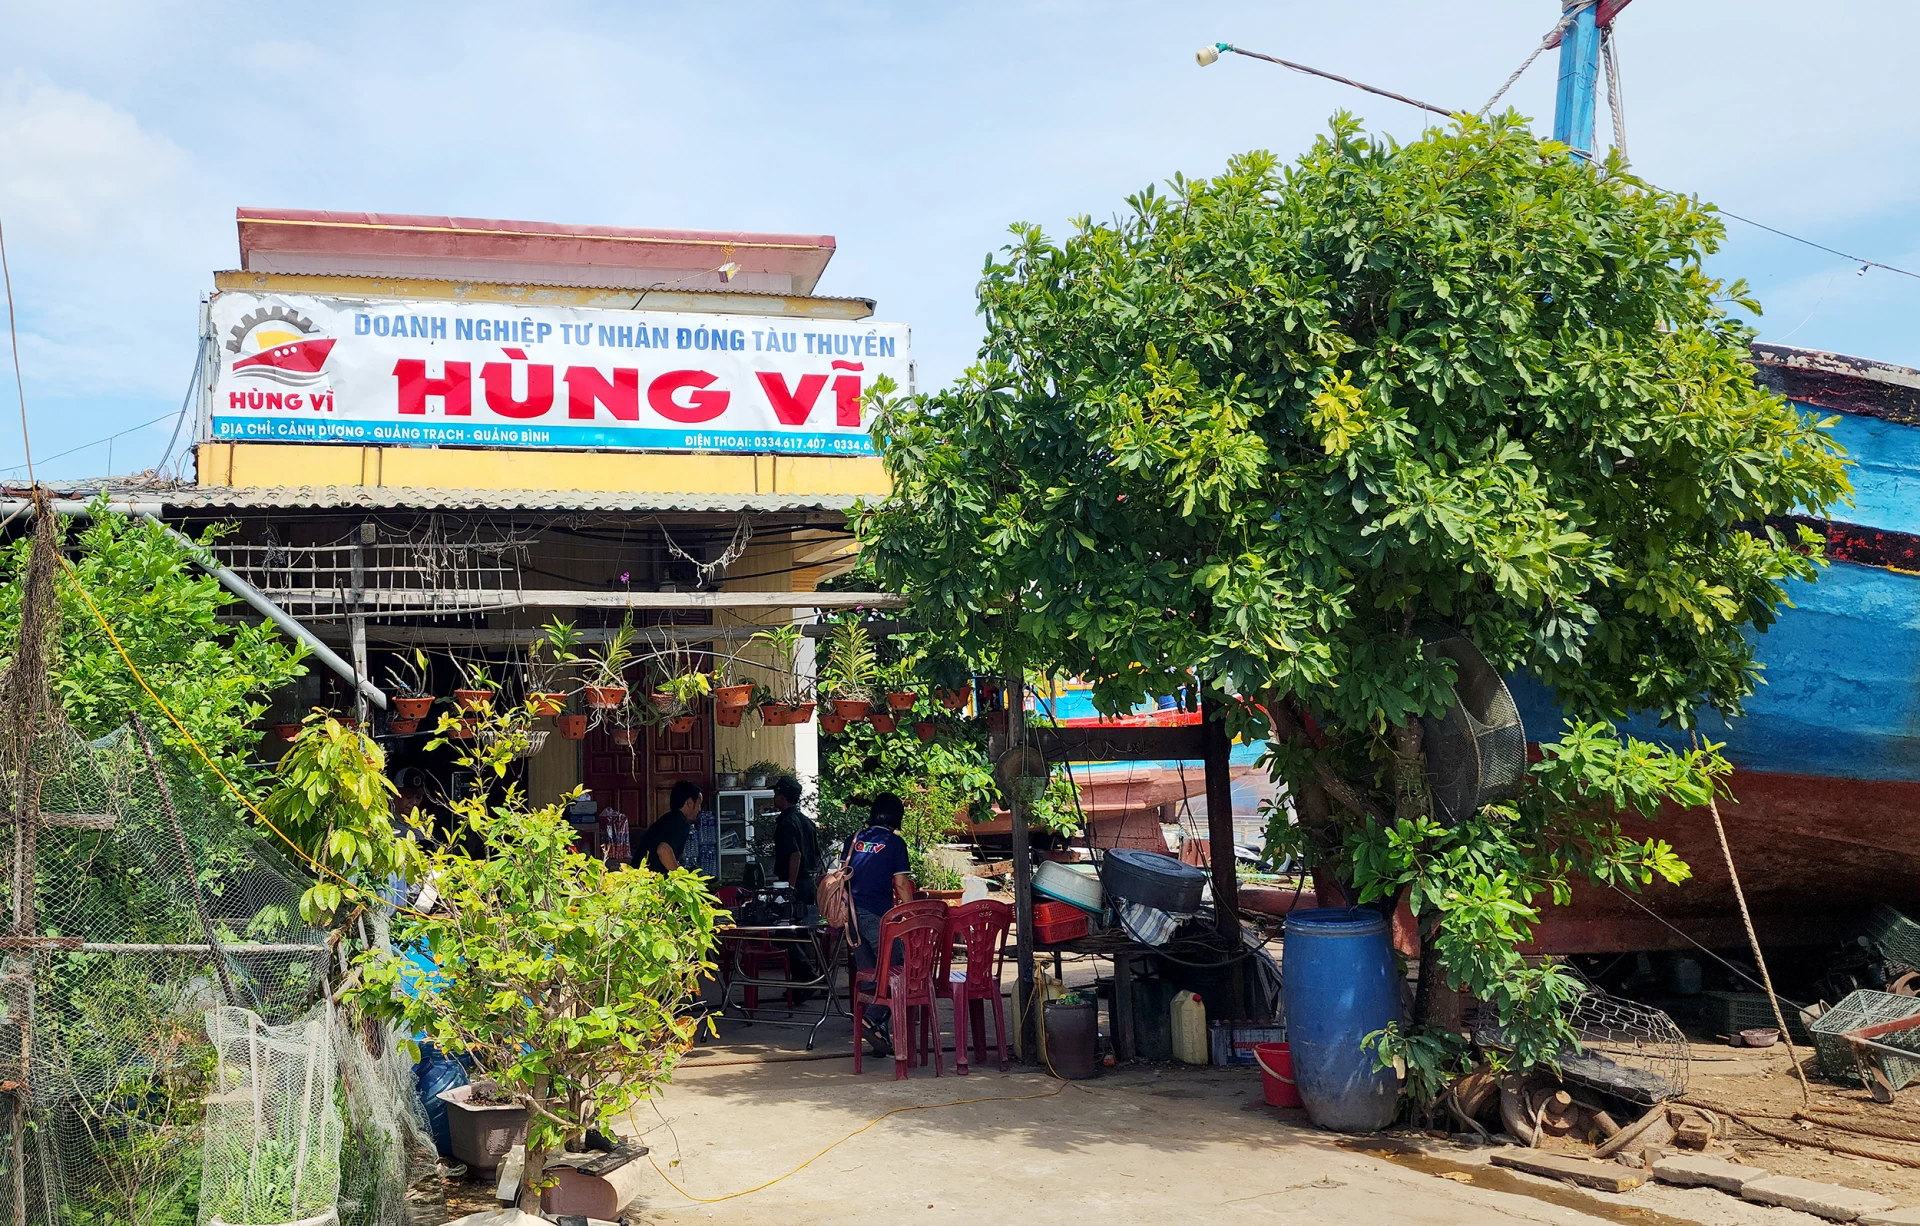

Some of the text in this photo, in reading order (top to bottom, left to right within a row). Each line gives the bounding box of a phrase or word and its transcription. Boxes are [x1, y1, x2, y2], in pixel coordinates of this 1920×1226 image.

[354, 313, 895, 357] DOANH NGHIỆP TƯ NHÂN ĐÓNG TÀU THUYỀN
[392, 347, 864, 427] HÙNG VĨ
[229, 388, 334, 412] HÙNG VĨ
[220, 422, 244, 436] ĐỊA
[247, 420, 275, 435] CHỈ:
[278, 421, 315, 436] CẢNH
[318, 423, 364, 438] DƯƠNG
[373, 424, 420, 439] QUẢNG
[423, 428, 464, 442] TRẠCH
[473, 427, 518, 442] QUẢNG
[521, 428, 549, 442] BÌNH
[685, 433, 711, 447] ĐIỆN
[713, 436, 752, 449] THOẠI:
[754, 437, 826, 449] 0334.617.407
